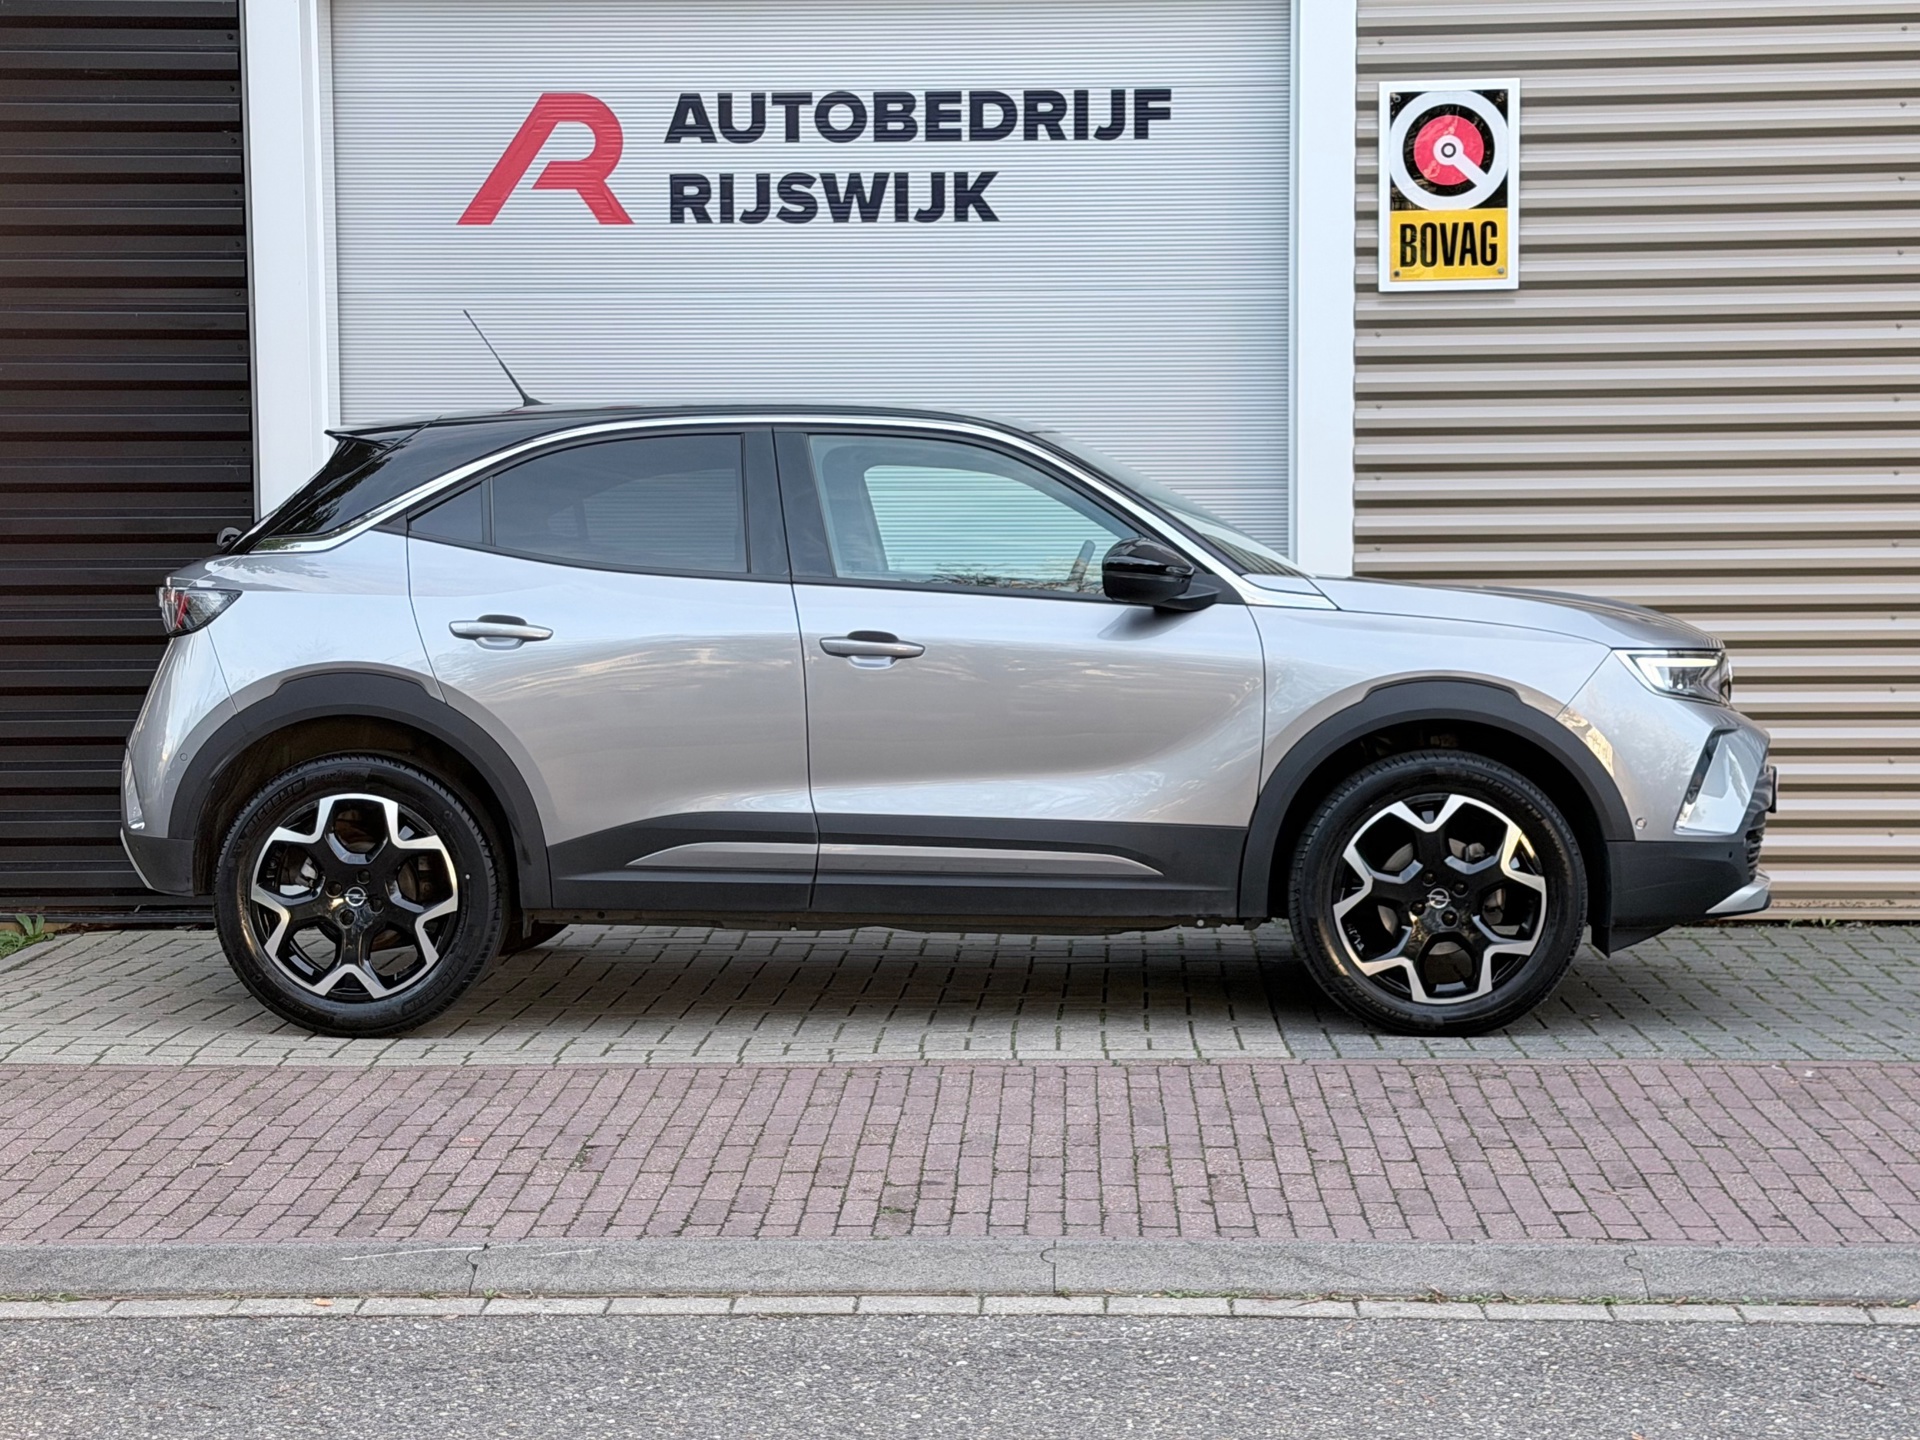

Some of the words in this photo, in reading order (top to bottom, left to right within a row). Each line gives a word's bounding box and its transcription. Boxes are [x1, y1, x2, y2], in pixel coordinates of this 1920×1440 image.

[664, 89, 1171, 143] AUTOBEDRIJF
[670, 172, 999, 224] RIJSWIJK
[1401, 221, 1497, 267] BOVAG
